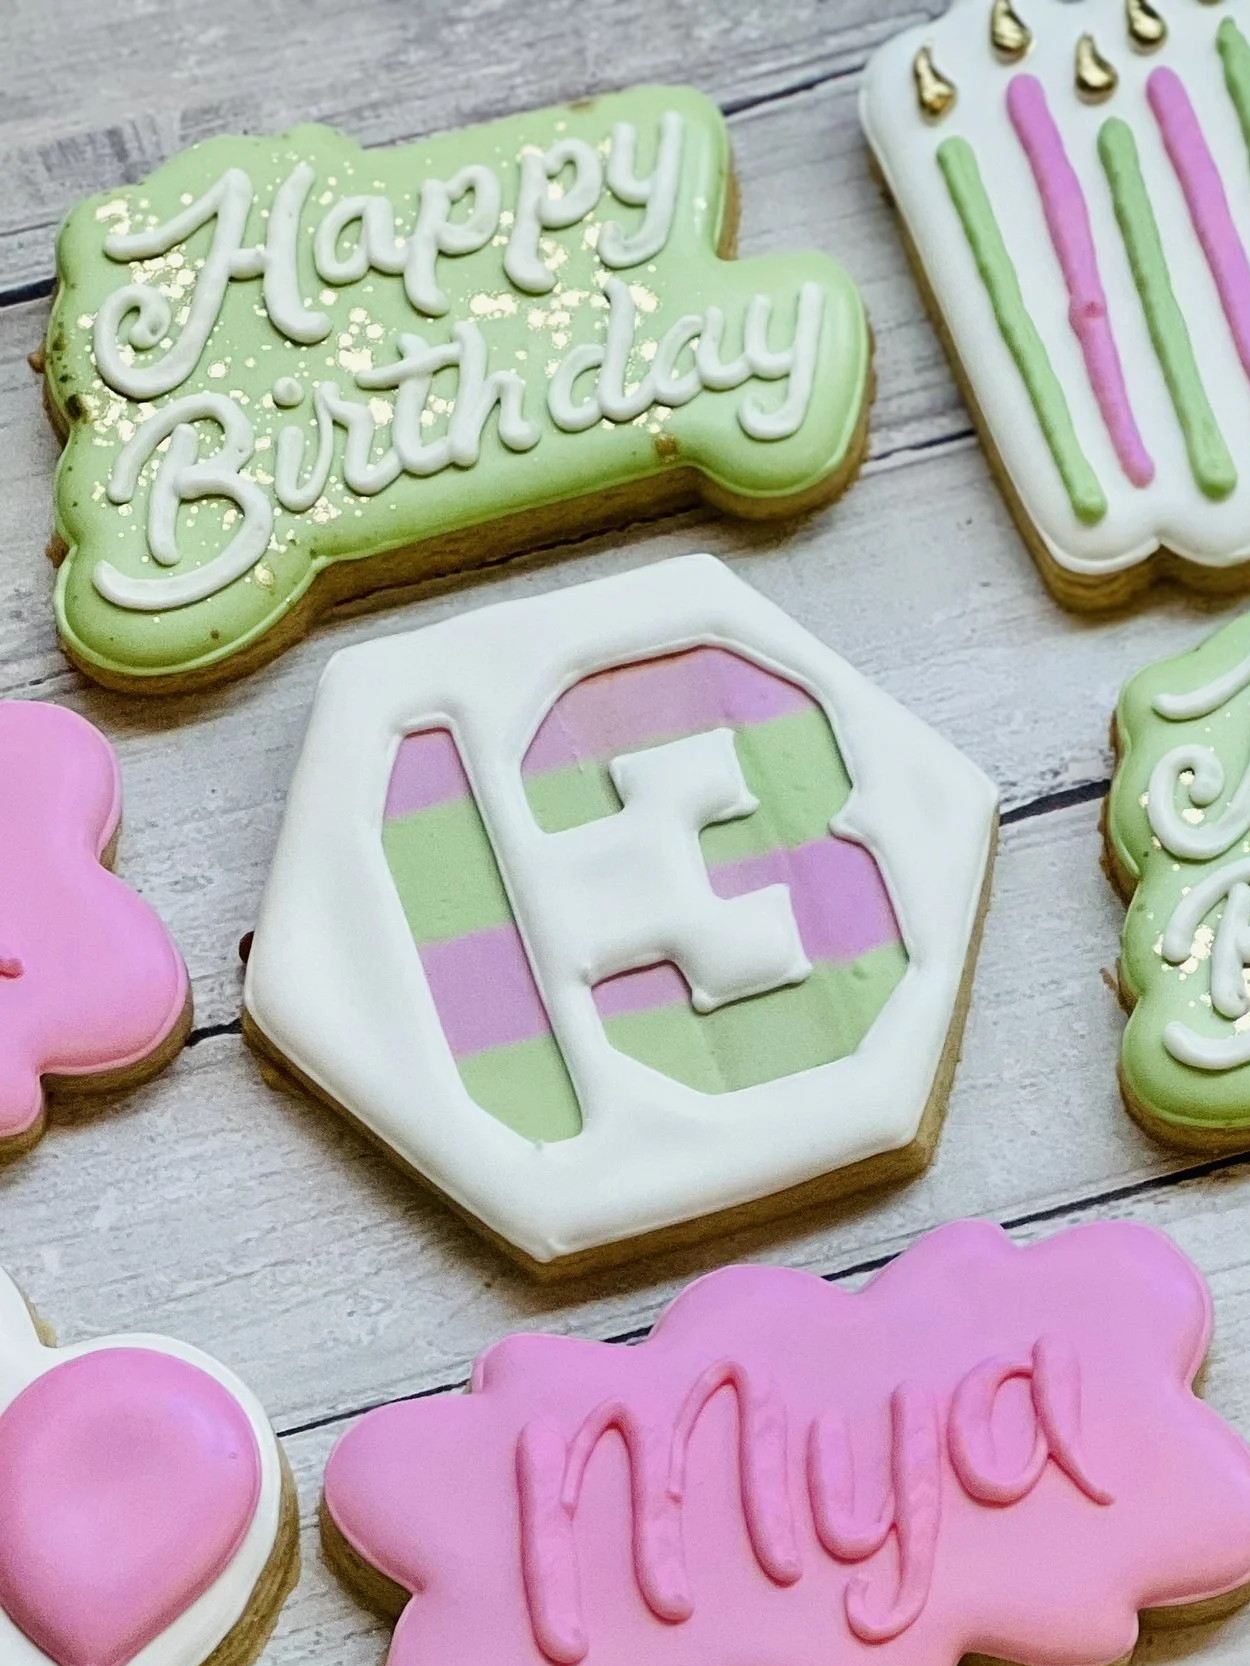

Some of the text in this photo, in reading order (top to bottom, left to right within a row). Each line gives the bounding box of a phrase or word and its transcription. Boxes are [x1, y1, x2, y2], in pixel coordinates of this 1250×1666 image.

[93, 110, 684, 398] Happy
[92, 278, 823, 611] Birthday
[381, 644, 911, 1146] 13
[515, 1336, 1116, 1666] Mya
